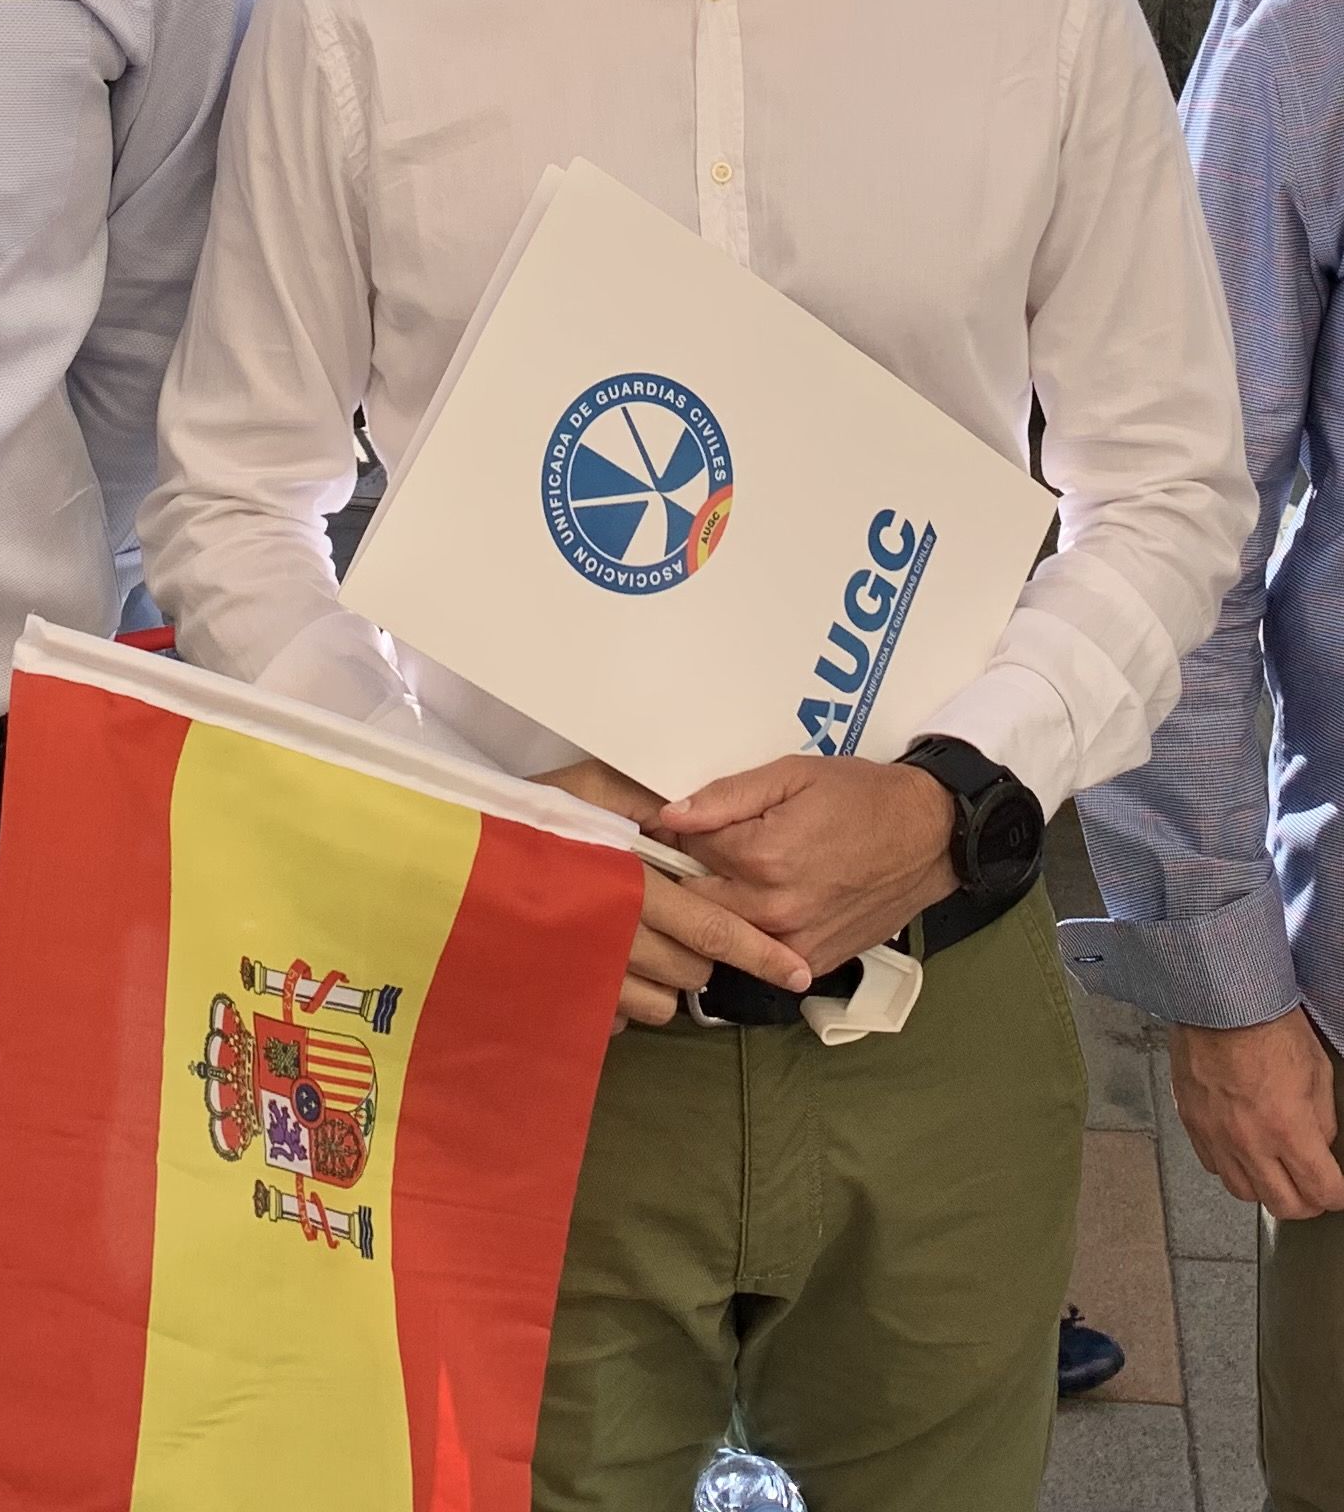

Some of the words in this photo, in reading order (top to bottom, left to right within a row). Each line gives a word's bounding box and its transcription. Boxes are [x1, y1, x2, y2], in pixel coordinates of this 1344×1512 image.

[570, 402, 593, 428] DE
[595, 380, 687, 409] GUARDIAS
[689, 407, 727, 482] CIVILES
[548, 432, 575, 545] UNIFICADA
[701, 511, 721, 545] AUGC
[573, 546, 684, 588] ASOCIACIÓN
[797, 508, 916, 757] AUGC
[863, 647, 890, 704] UNIFICADA
[886, 629, 897, 645] DE
[892, 575, 918, 629] GUARDIAS
[914, 534, 934, 575] CIVILES
